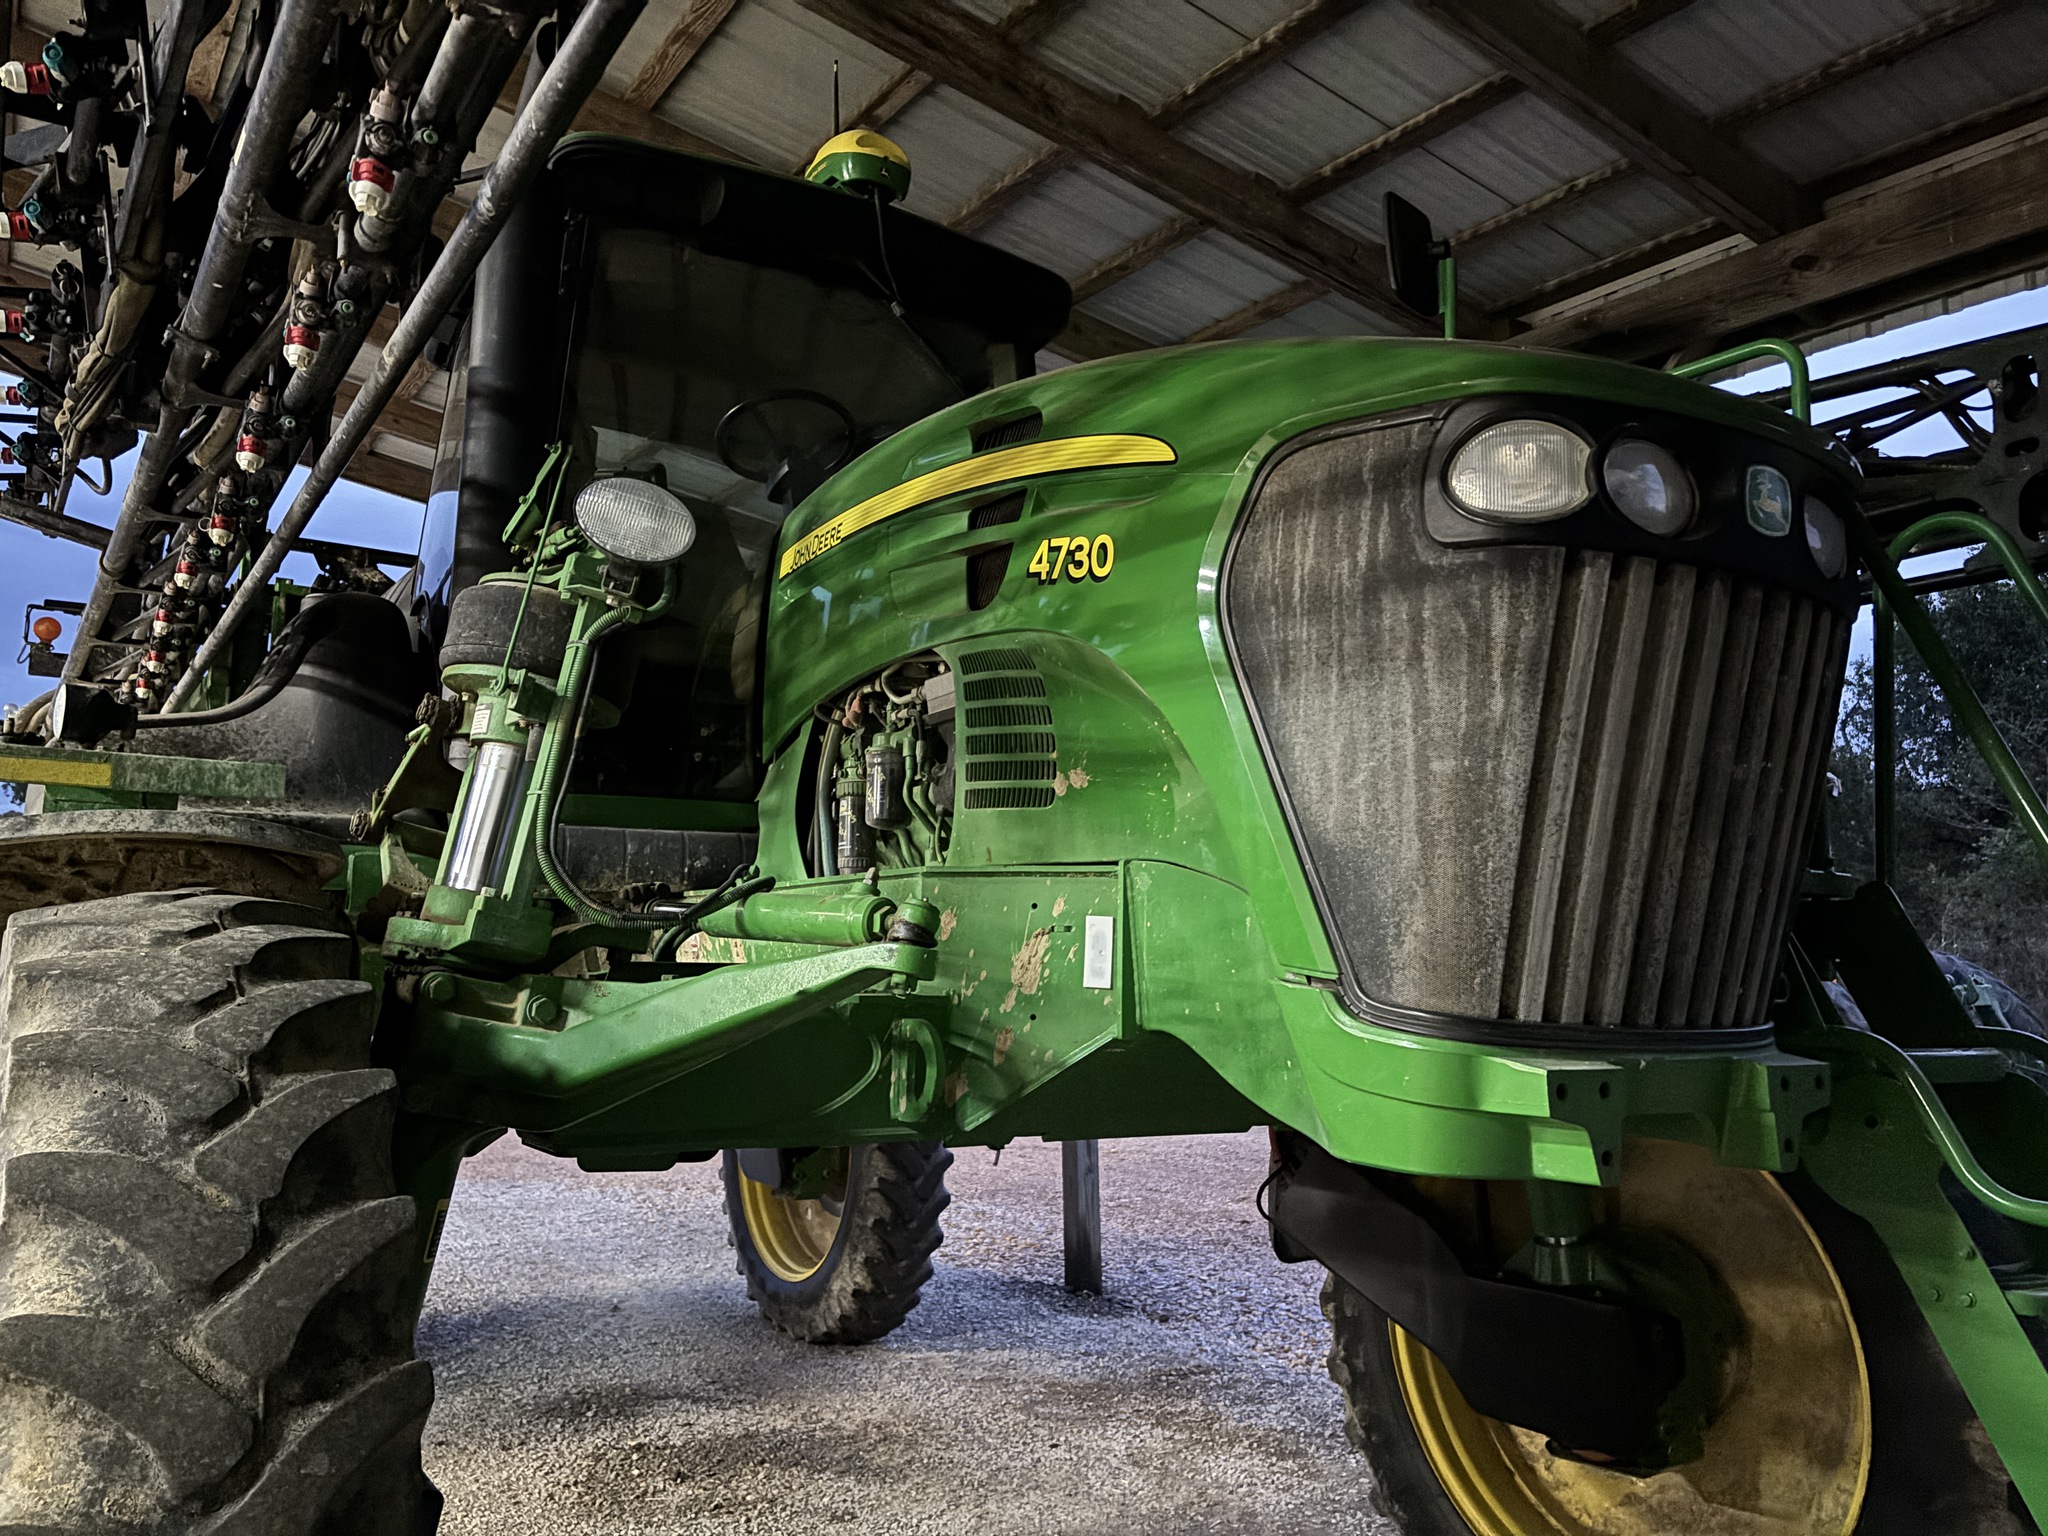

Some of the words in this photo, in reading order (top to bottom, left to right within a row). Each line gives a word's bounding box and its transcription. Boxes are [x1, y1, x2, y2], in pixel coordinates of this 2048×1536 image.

[789, 541, 812, 570] JOHN
[811, 522, 843, 556] DEERE
[1027, 533, 1115, 585] 4730
